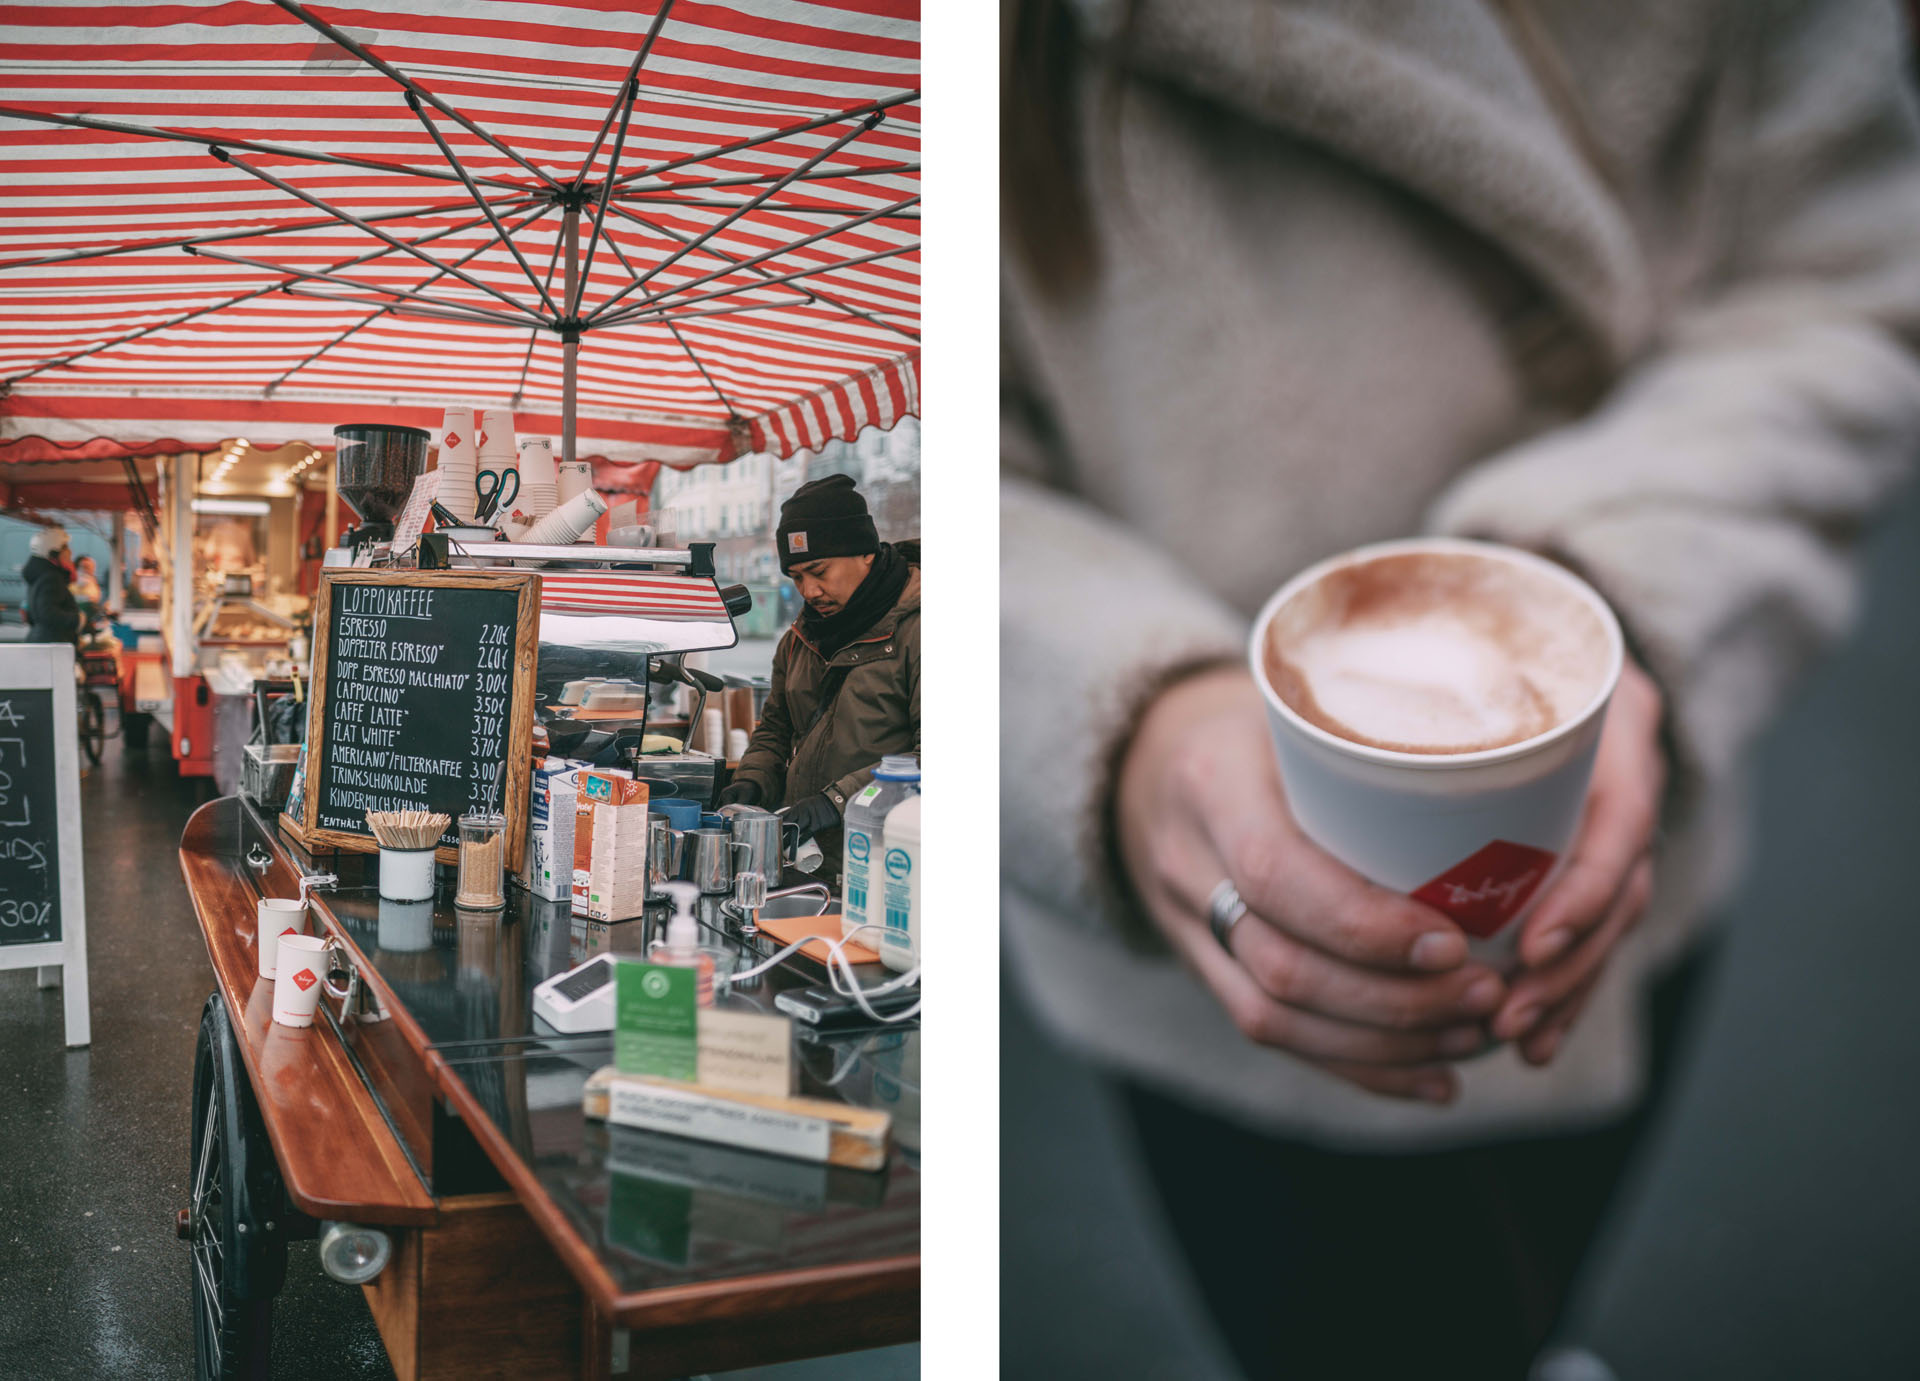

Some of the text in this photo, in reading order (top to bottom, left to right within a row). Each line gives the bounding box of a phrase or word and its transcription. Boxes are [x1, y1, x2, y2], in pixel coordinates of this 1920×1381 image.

[342, 587, 434, 617] LOPPOKAFFEE
[339, 617, 510, 645] ESPRESSO 2.20€
[338, 638, 387, 660] DOPPELTER
[477, 647, 508, 670] 2.60€
[337, 660, 358, 680] DOPP.
[363, 664, 406, 685] ESPRESSO
[475, 672, 507, 694] 3.00€
[335, 701, 364, 722] CAFFE
[471, 715, 503, 737] 3.70€
[473, 695, 505, 715] 3.50€
[332, 722, 357, 742] FLAT
[470, 736, 501, 758] 3.70€
[331, 765, 428, 794] TRINKSCHOKOLADE
